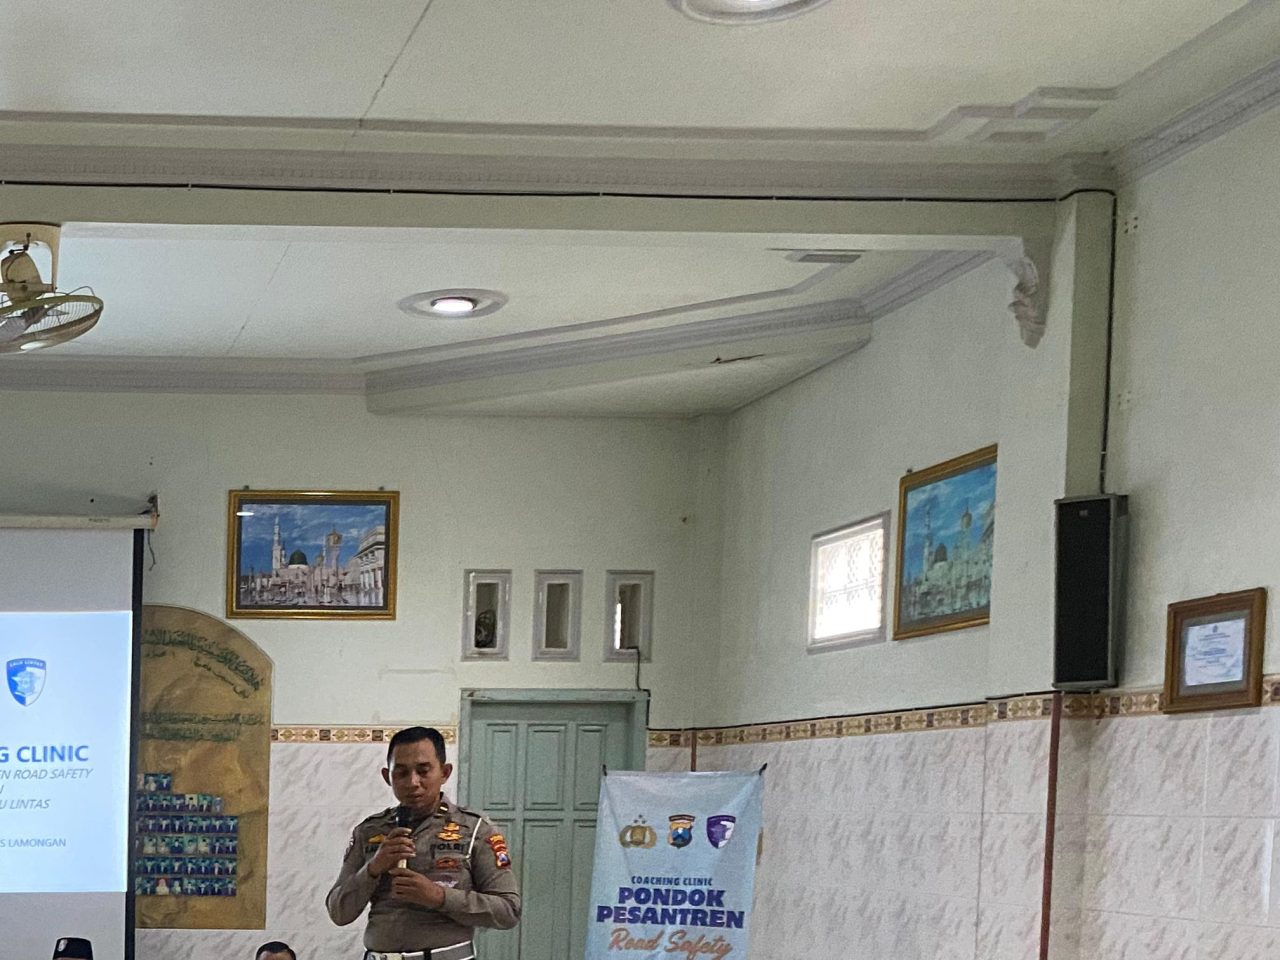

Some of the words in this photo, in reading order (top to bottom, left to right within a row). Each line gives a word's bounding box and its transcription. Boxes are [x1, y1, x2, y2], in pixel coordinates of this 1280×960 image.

[16, 745, 89, 762] CLINIC
[13, 769, 48, 780] ROAD
[49, 768, 94, 779] SAFETY
[9, 799, 51, 809] LINTAS
[8, 838, 66, 847] LAMONGAN
[631, 875, 680, 886] COACHING
[683, 877, 713, 887] CLINIC
[618, 886, 727, 908] PONDOK
[596, 905, 745, 929] PESANTREN
[608, 927, 665, 951] Road
